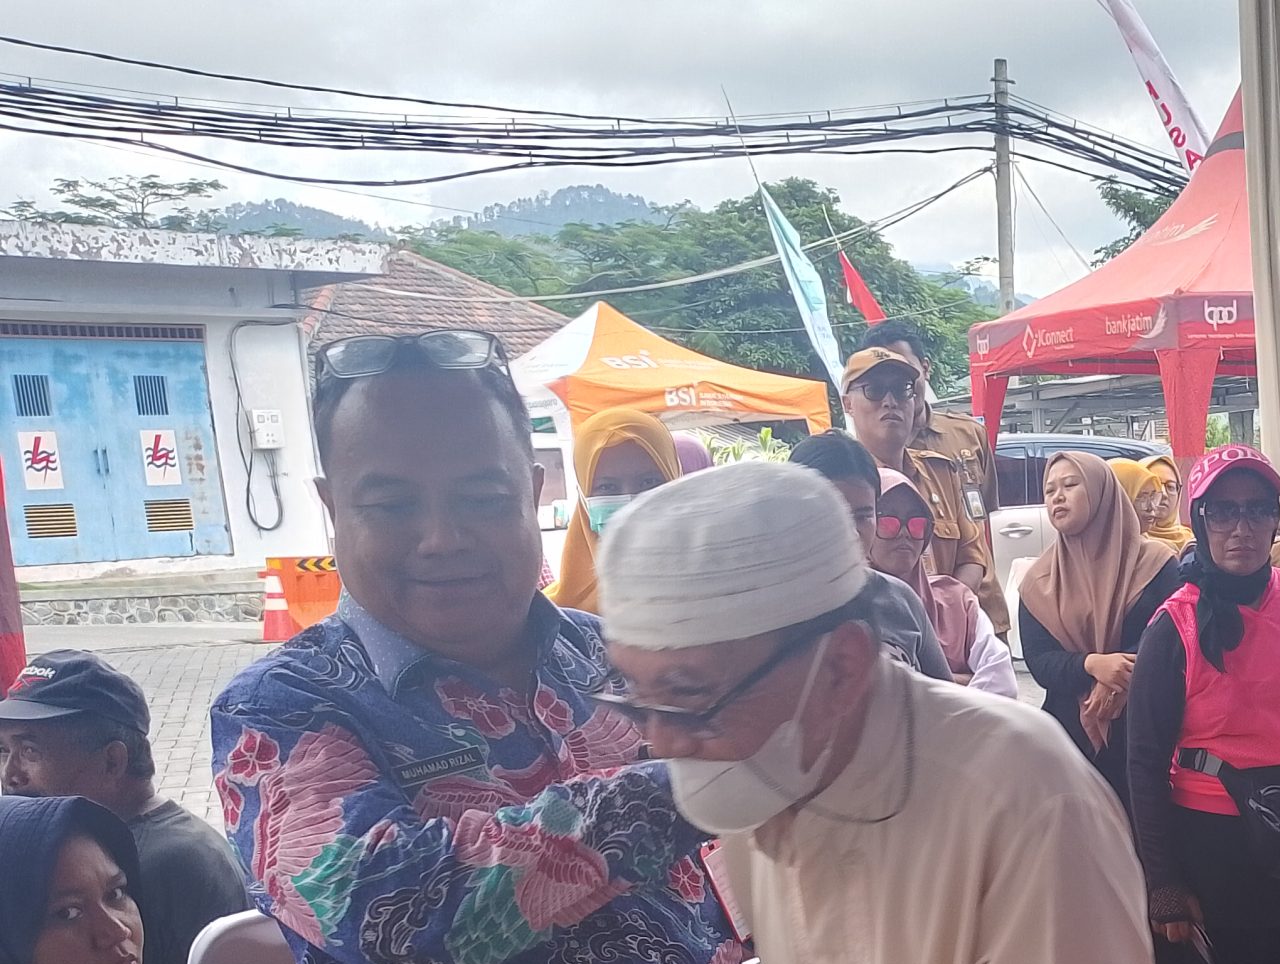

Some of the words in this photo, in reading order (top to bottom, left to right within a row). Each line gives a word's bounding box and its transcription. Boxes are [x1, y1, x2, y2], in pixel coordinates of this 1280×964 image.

[1105, 314, 1153, 338] bankjatim
[401, 760, 449, 779] MUHAMAD
[449, 753, 477, 768] RIZAL
